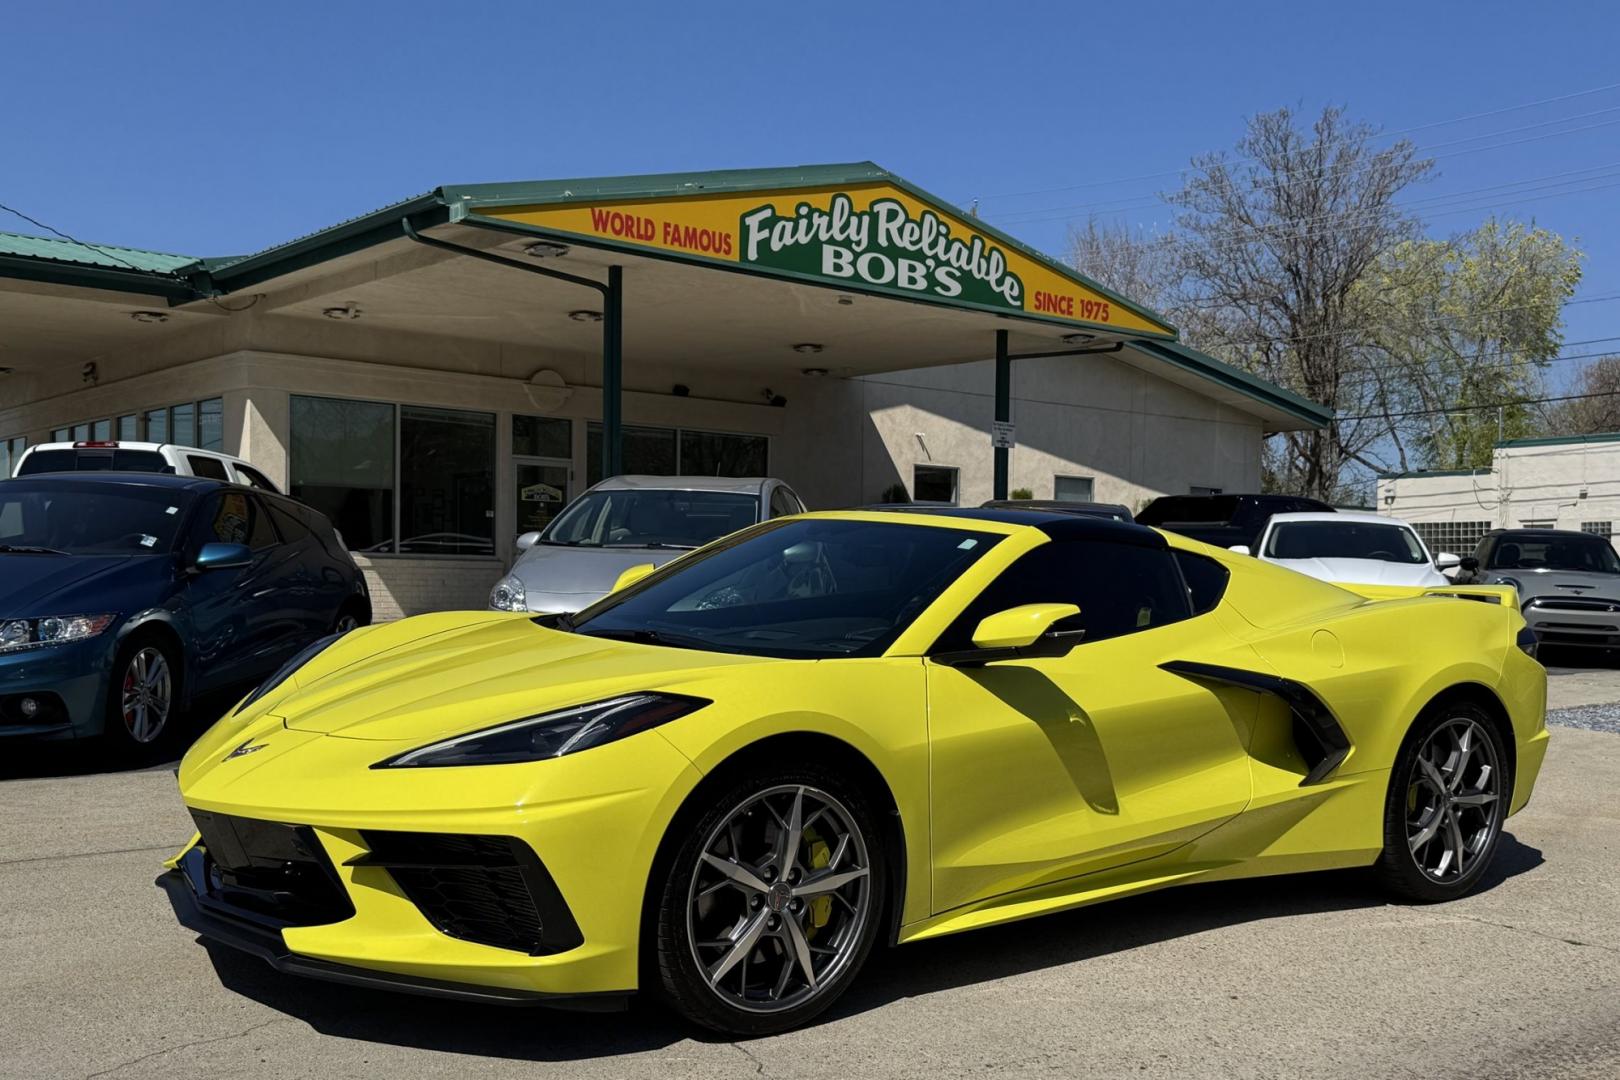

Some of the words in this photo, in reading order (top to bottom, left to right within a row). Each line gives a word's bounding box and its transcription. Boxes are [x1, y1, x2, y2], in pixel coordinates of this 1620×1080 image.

[591, 207, 656, 242] WORLD
[663, 221, 732, 256] FAMOUS
[745, 197, 870, 261] Fairly
[873, 201, 1022, 306] Reliable
[822, 243, 962, 297] BOB'S
[1034, 290, 1074, 316] SINCE
[1080, 299, 1109, 323] 1975
